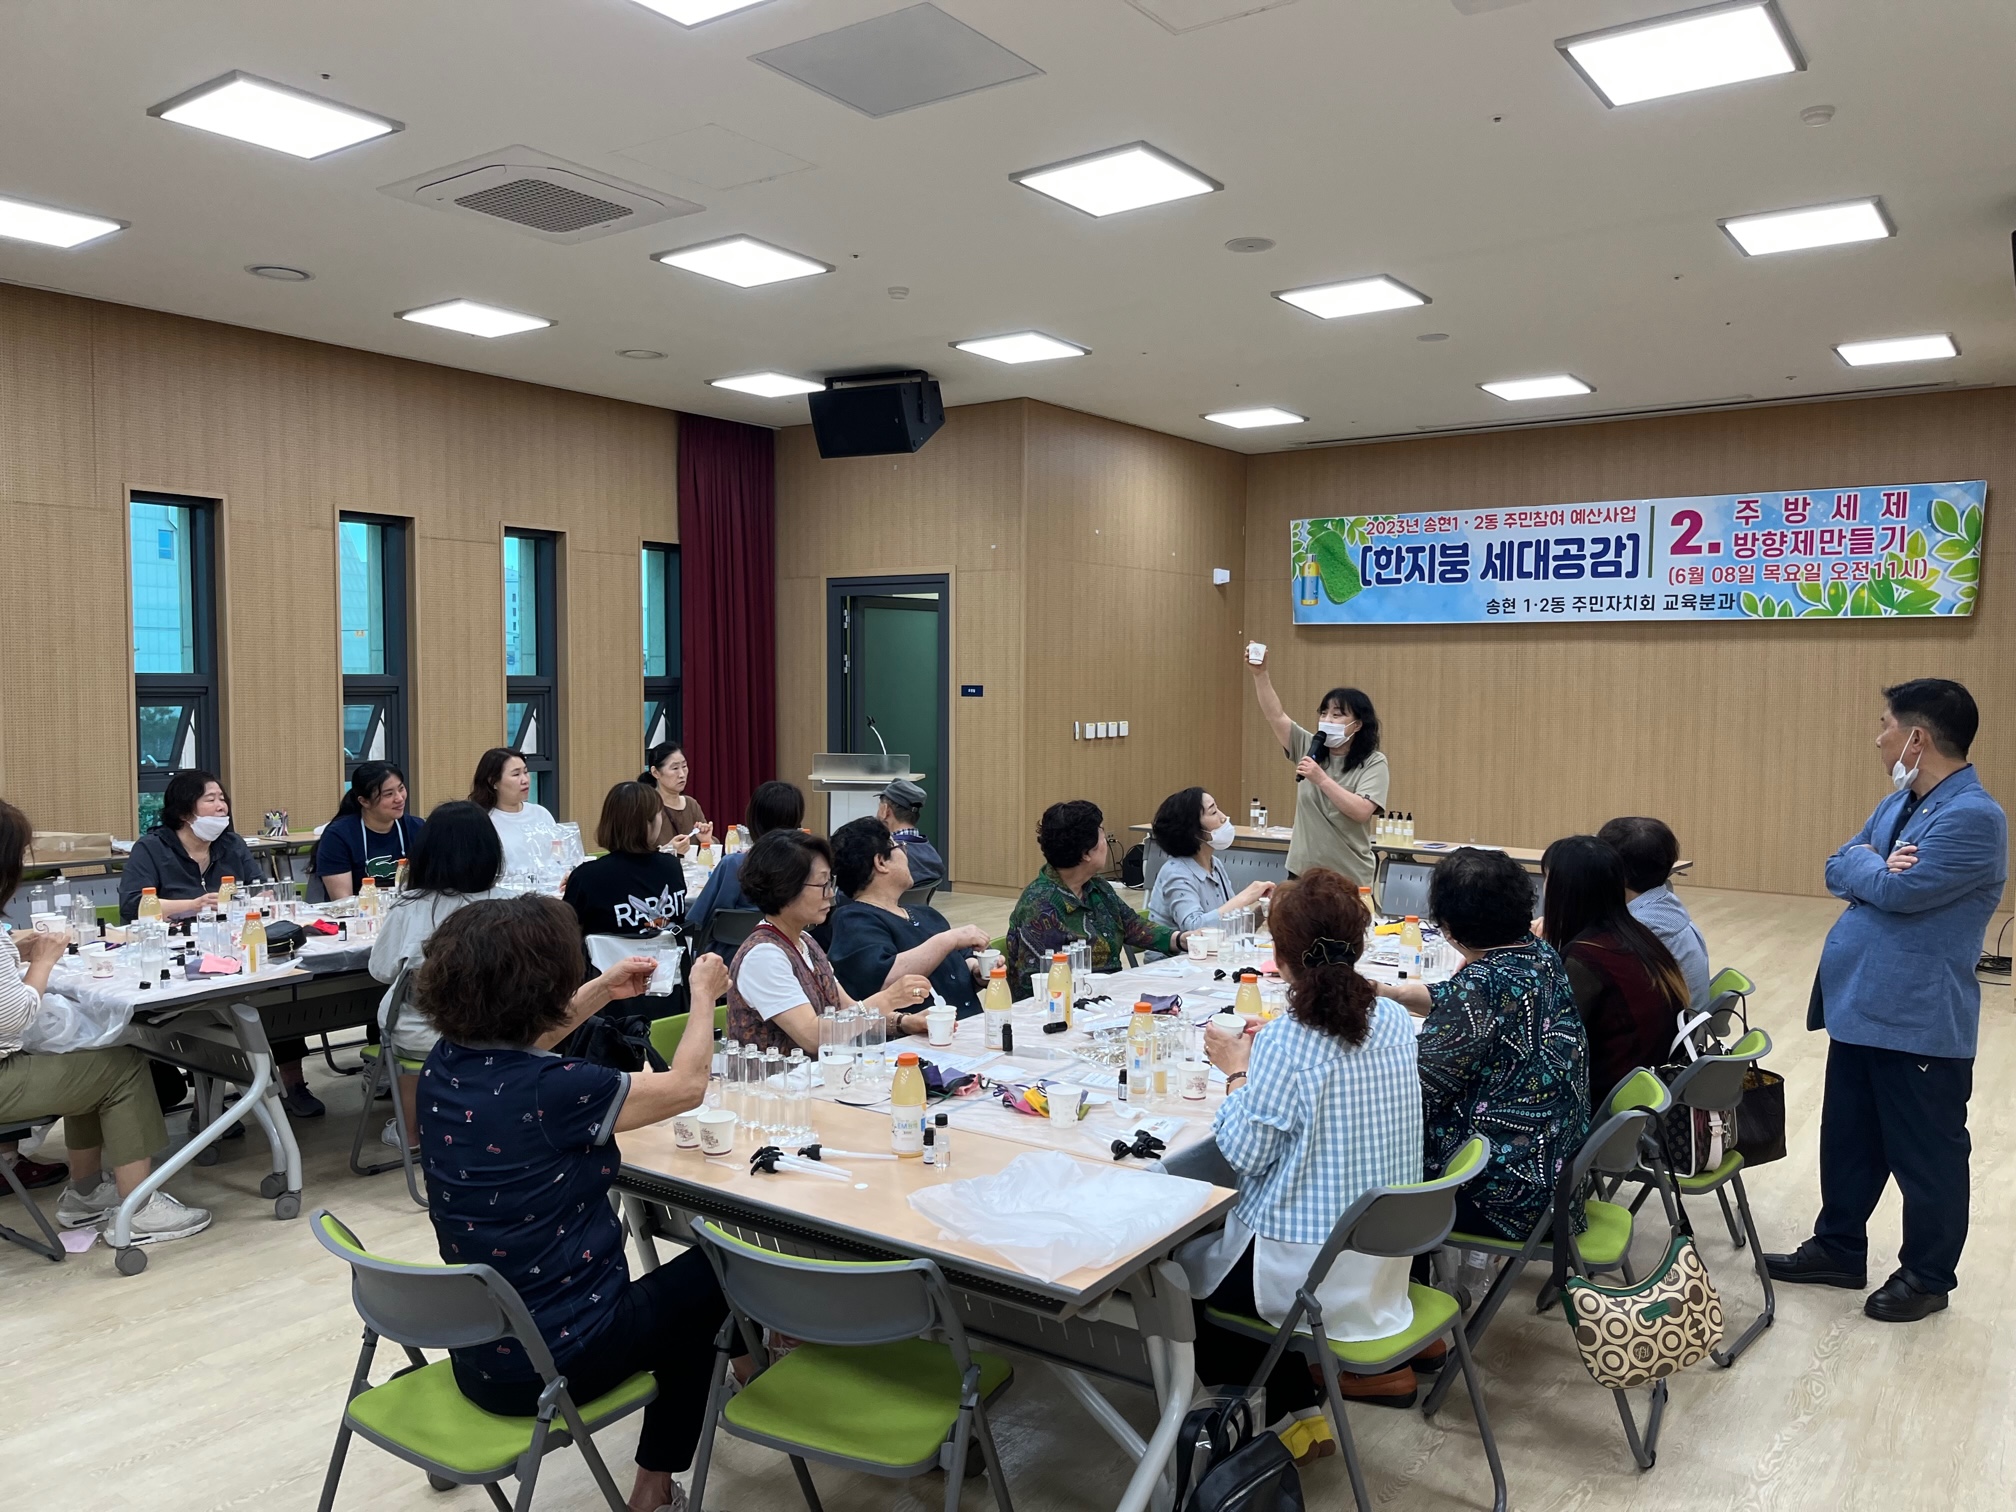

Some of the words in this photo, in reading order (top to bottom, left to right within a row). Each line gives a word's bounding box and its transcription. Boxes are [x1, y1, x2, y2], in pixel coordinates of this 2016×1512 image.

[1366, 518, 1419, 535] 2023년
[1503, 510, 1565, 529] 주민참여
[1570, 506, 1636, 525] 예산사업
[1670, 509, 1721, 556] 2.
[1733, 525, 1906, 559] 방향제만들기
[1360, 541, 1470, 587] [한지붕
[1480, 533, 1640, 582] 세대공감]
[1668, 566, 1704, 586] (6월
[1711, 564, 1755, 584] 08일
[1762, 562, 1822, 583] 목요일
[1830, 558, 1928, 581] 오전11시)
[1486, 597, 1516, 615] 송현
[1572, 594, 1656, 612] 주민자치회
[1662, 592, 1735, 611] 교육분과
